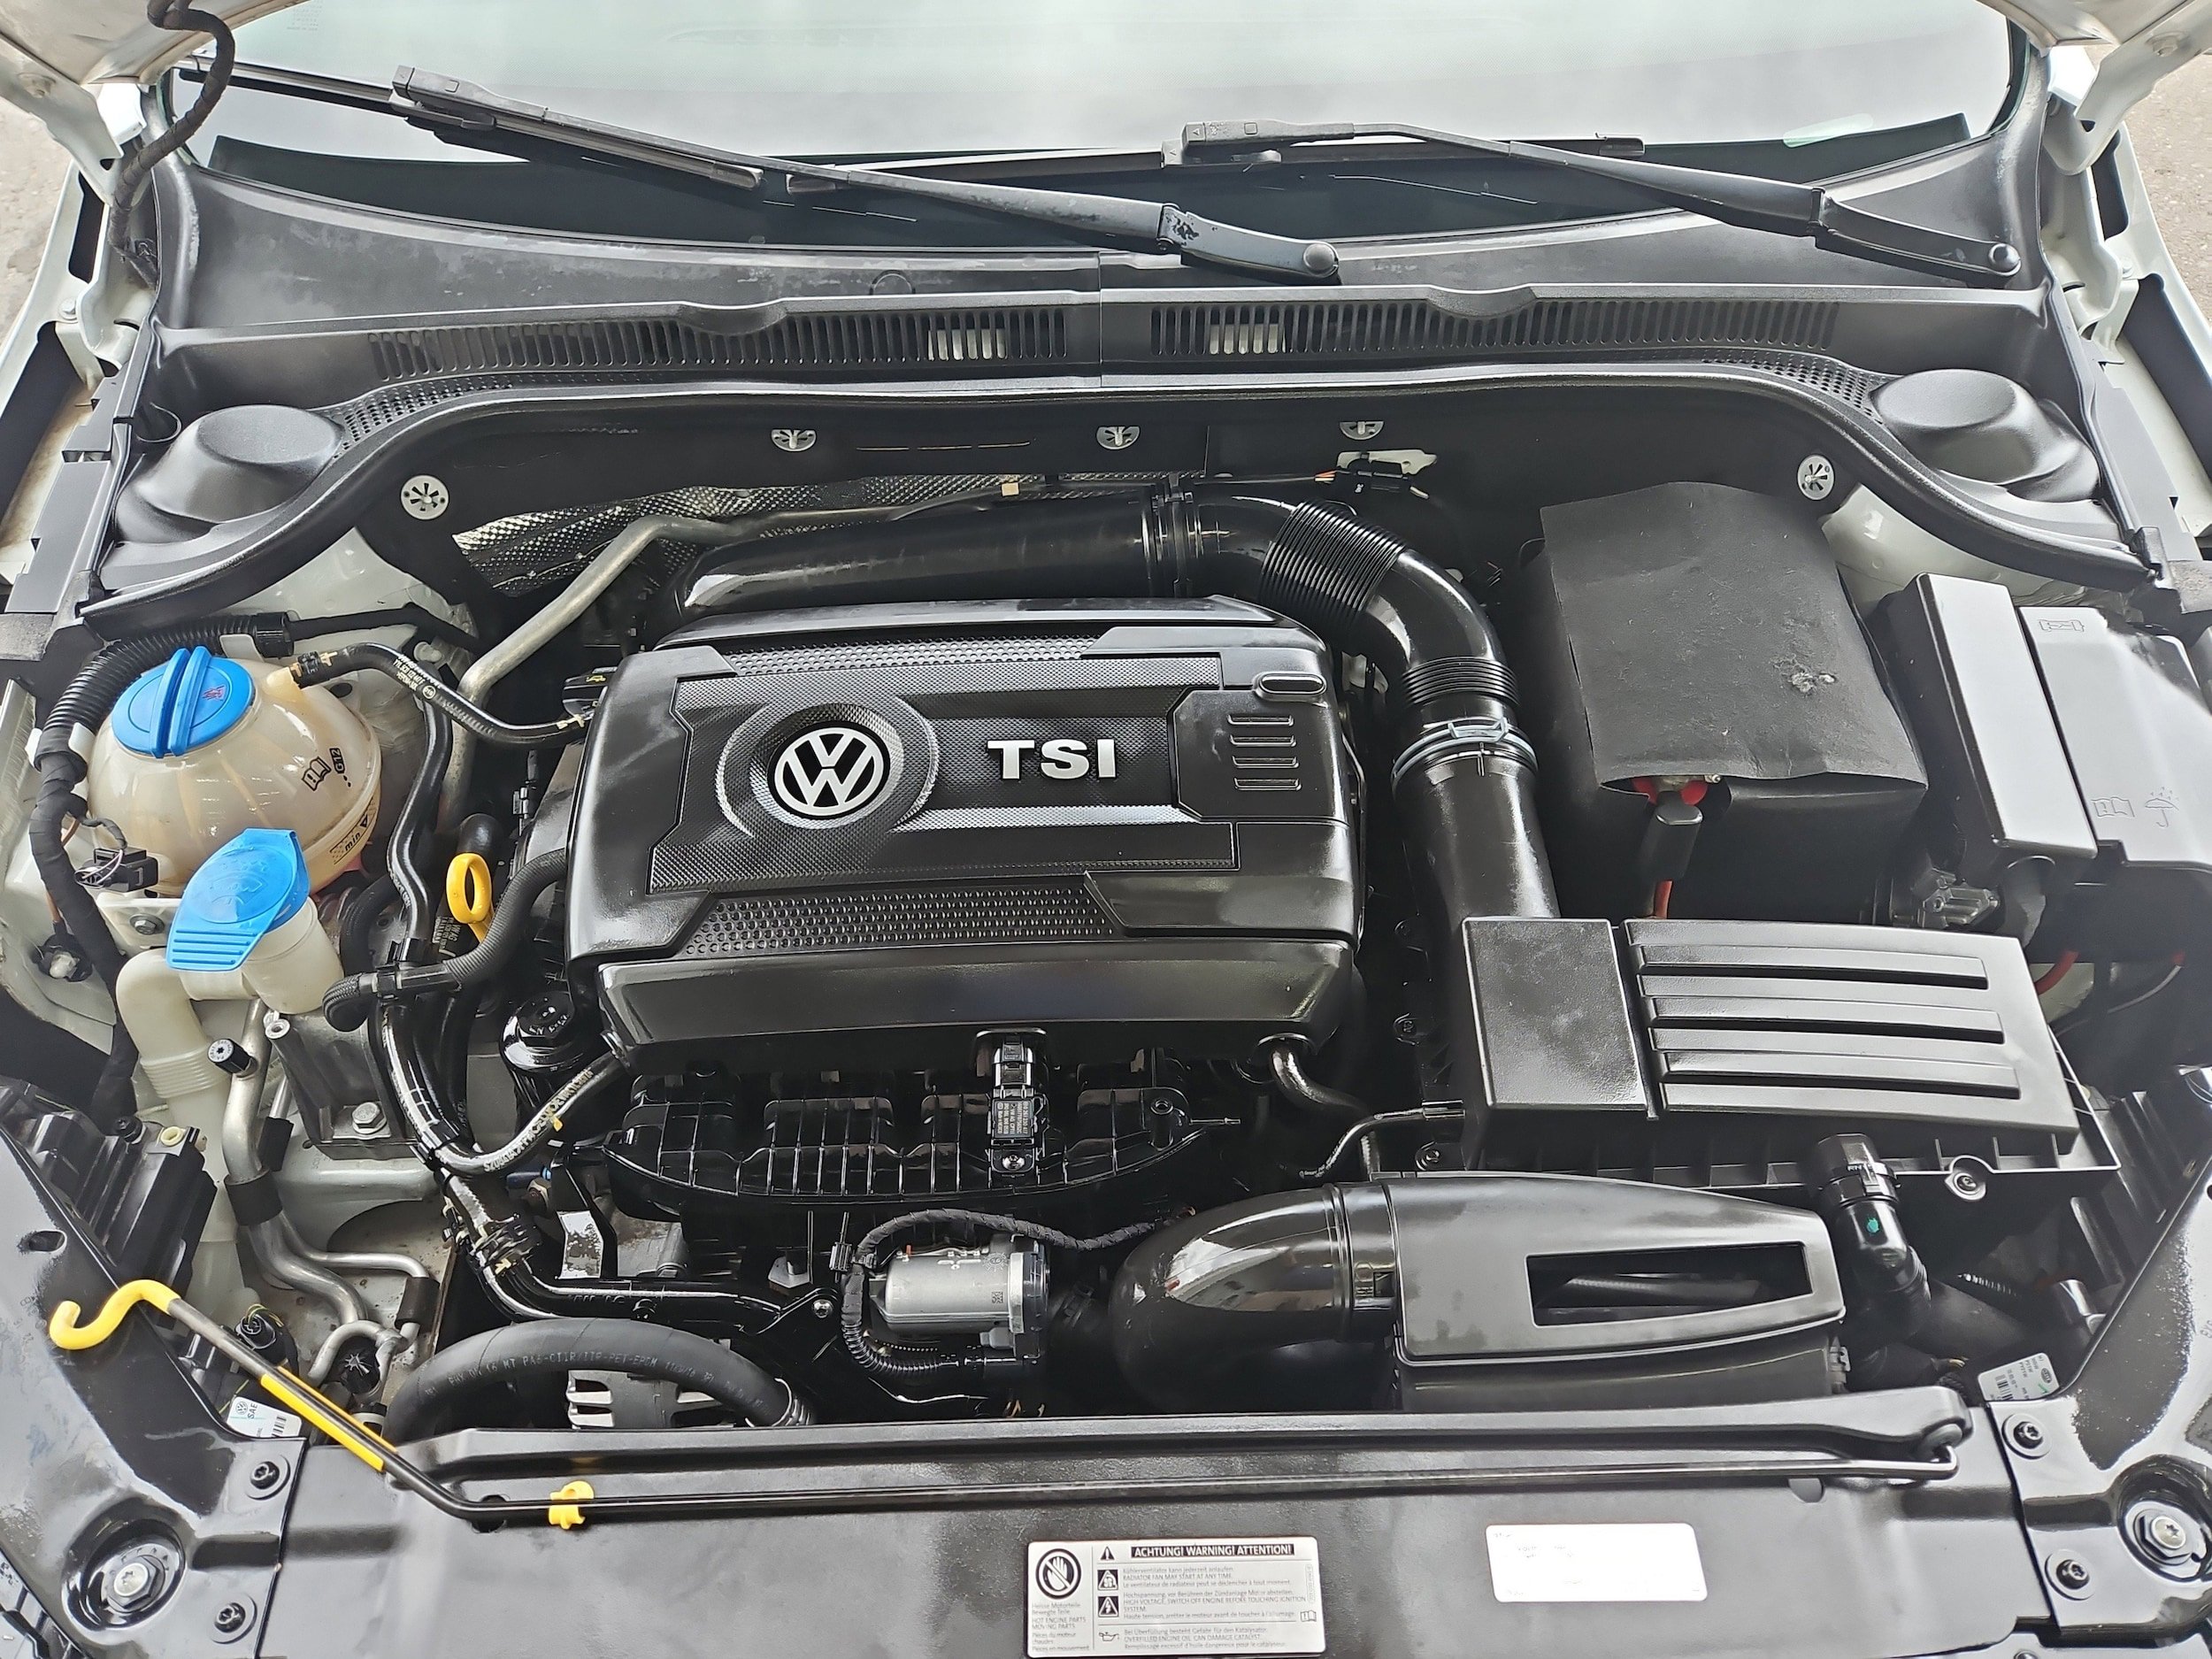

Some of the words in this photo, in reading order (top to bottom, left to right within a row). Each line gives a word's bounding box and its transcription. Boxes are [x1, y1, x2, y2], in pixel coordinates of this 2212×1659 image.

[331, 749, 344, 772] G12
[987, 739, 1116, 779] TSI
[774, 727, 884, 816] VW
[344, 832, 361, 851] min
[248, 1403, 258, 1419] SAE
[1134, 1547, 1184, 1557] ACHTUNG!
[1187, 1546, 1235, 1555] WARNING!
[1237, 1545, 1291, 1555] ATTENTION!
